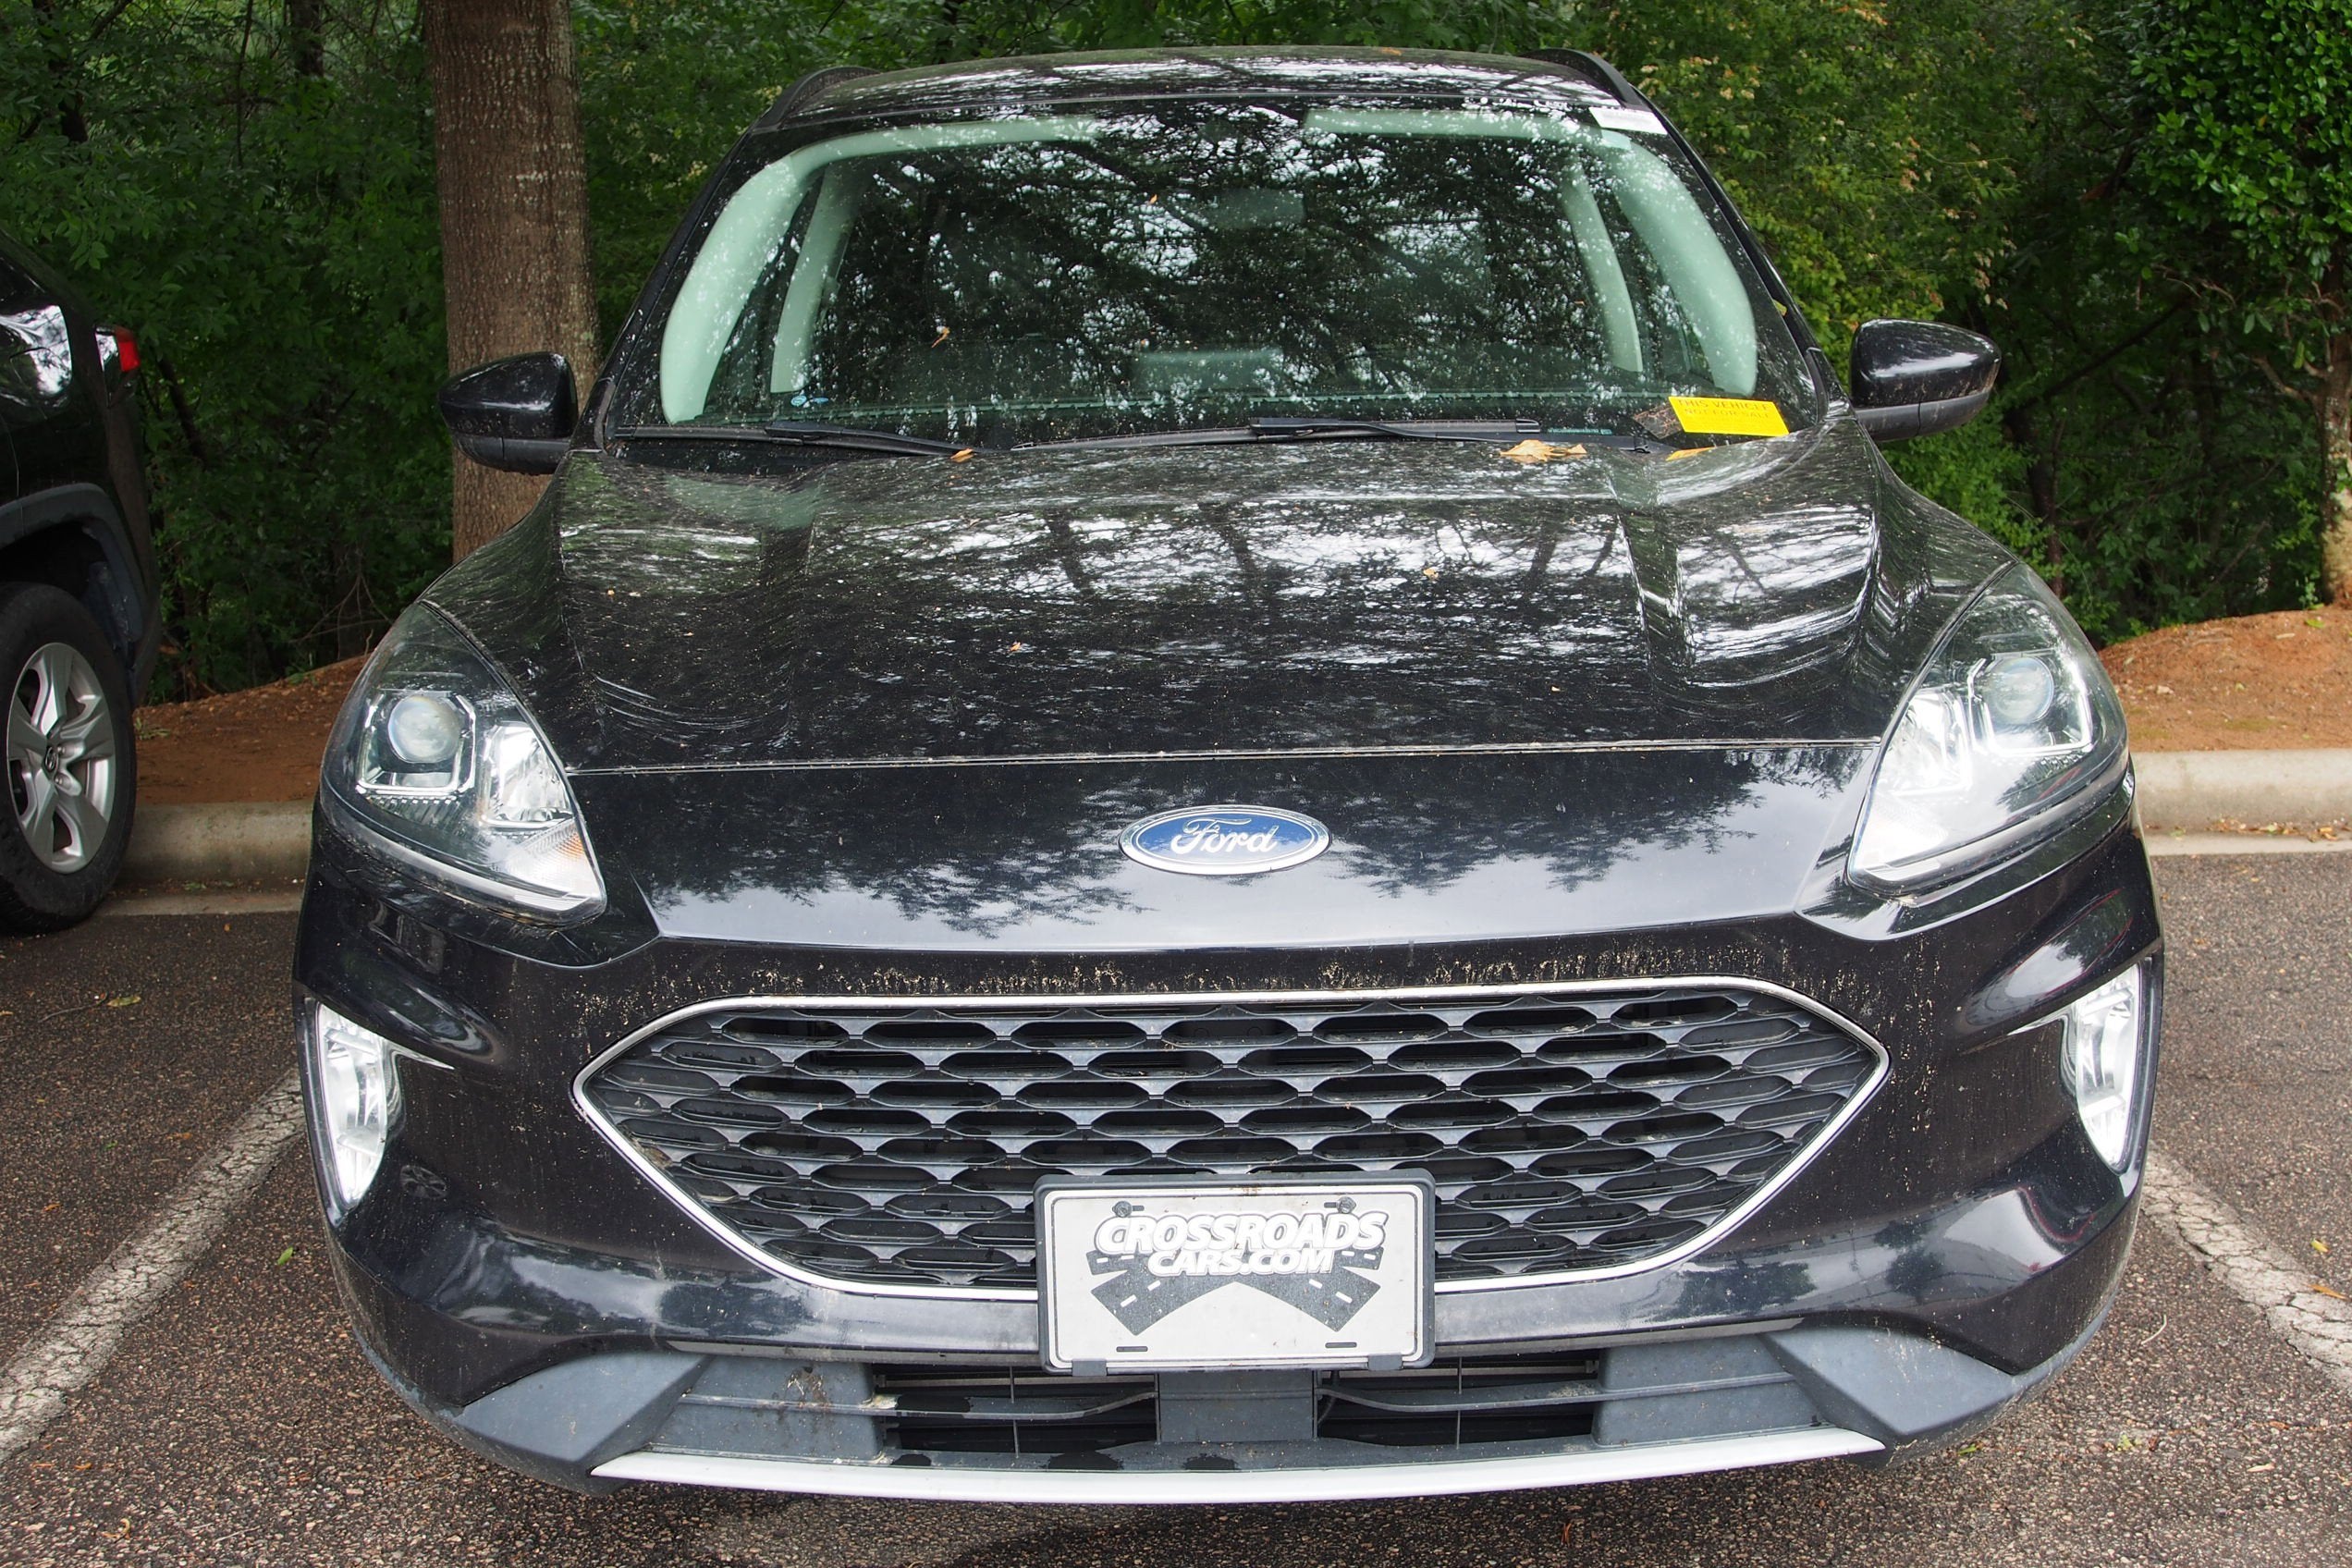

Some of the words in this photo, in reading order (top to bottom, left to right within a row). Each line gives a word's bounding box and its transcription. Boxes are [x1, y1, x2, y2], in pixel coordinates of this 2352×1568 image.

[1678, 398, 1709, 408] THIS
[1713, 400, 1770, 410] VEHICLE
[1170, 817, 1279, 853] Ford
[1095, 1211, 1389, 1253] CROSSROADS
[1147, 1247, 1336, 1277] CARS.COM
